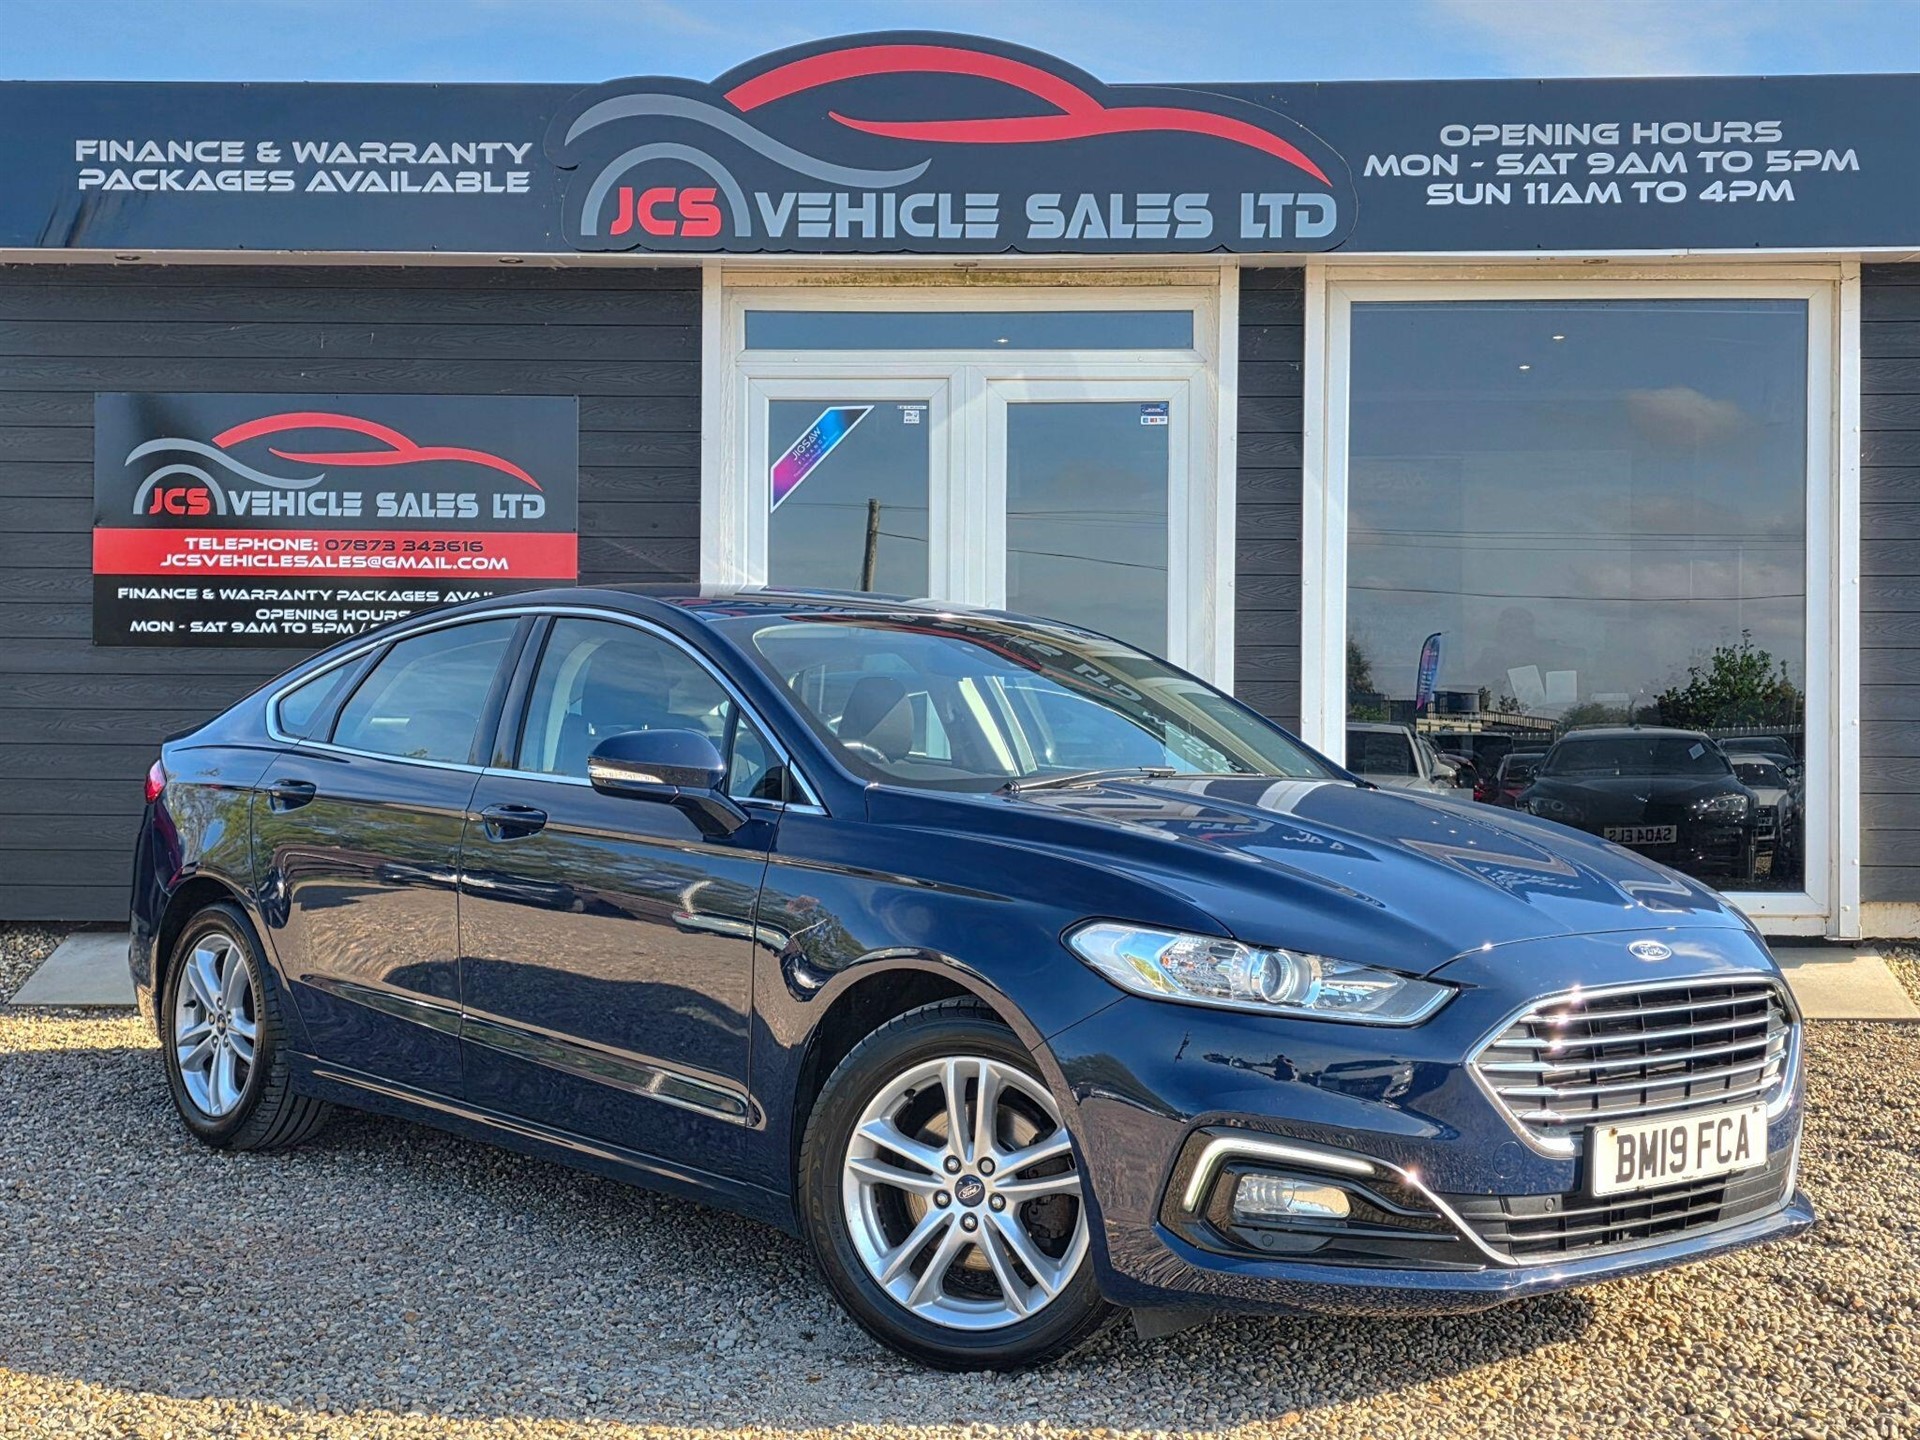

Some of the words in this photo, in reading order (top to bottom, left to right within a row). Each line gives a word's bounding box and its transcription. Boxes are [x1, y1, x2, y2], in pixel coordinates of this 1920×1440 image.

[1439, 122, 1620, 147] OPENING
[1631, 120, 1783, 145] HOURS
[75, 140, 246, 162] FINANCE
[256, 142, 281, 162] &
[292, 142, 534, 164] WARRANTY
[1363, 154, 1460, 176] MON
[1496, 152, 1579, 175] SAT
[1586, 152, 1689, 174] 9AM
[1696, 151, 1756, 173] TO
[1765, 148, 1861, 172] 5PM
[78, 169, 296, 191] PACKAGES
[304, 171, 531, 193] AVAILABLE
[1426, 183, 1512, 205] SUN
[1523, 182, 1622, 204] 11AM
[1630, 181, 1687, 203] TO
[1698, 180, 1796, 202] 4PM
[609, 187, 723, 237] JCS
[754, 192, 1001, 239] VEHICLE
[1025, 194, 1214, 239] SALES
[1239, 193, 1337, 239] LTD
[792, 426, 821, 461] JIGSAW
[148, 487, 211, 515] JCS
[227, 491, 362, 517] VEHICLE
[376, 493, 479, 518] SALES
[492, 493, 545, 519] LTD
[184, 537, 318, 551] TELEPHONE:
[324, 540, 396, 552] 07873
[402, 540, 484, 553] 343616
[159, 554, 509, 571] JCSVEHICLESALES@GMAIL.COM
[117, 587, 198, 600] FINANCE
[202, 588, 215, 600] &
[219, 589, 331, 601] WARRANTY
[336, 590, 439, 602] PACKAGES
[129, 619, 174, 632] MON
[190, 621, 227, 633] SAT
[231, 621, 277, 633] 9AM
[281, 622, 307, 633] TO
[311, 623, 354, 634] 5PM
[255, 608, 338, 621] OPENING
[1616, 1125, 1688, 1184] BM19
[1697, 1114, 1750, 1169] FCA
